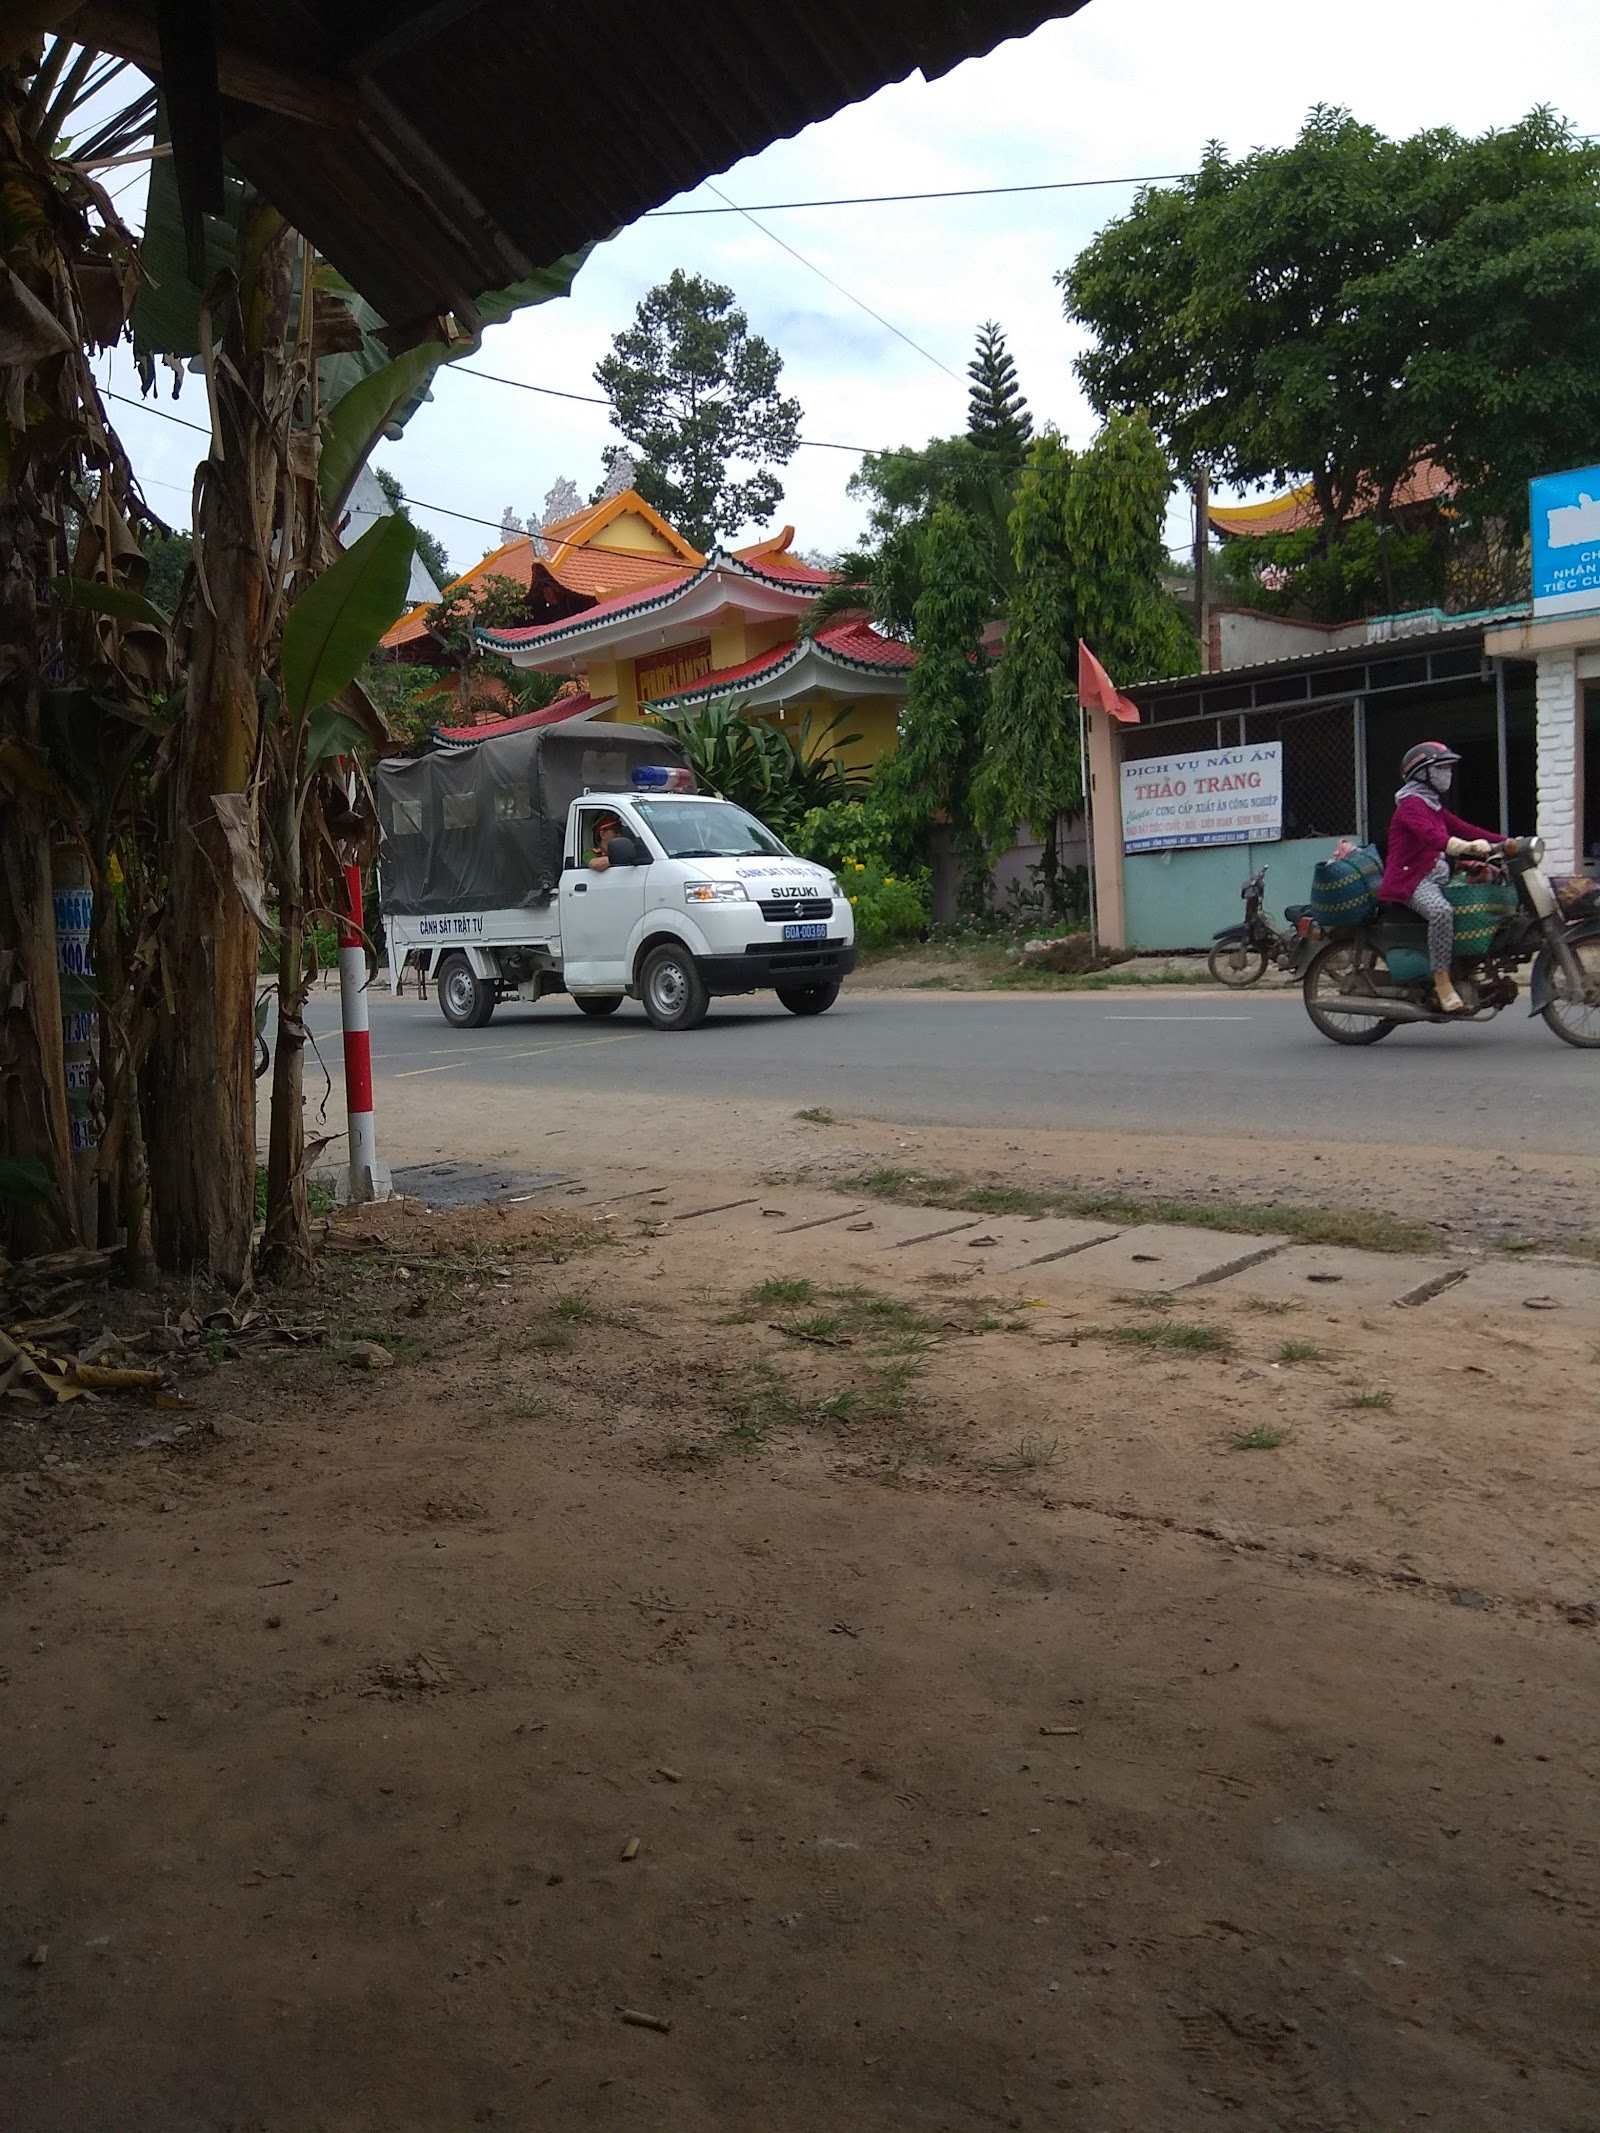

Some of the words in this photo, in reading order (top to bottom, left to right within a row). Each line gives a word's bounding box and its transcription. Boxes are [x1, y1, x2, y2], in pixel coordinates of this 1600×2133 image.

[1543, 579, 1577, 593] TIỆC
[1126, 764, 1169, 778] DỊCH
[1175, 760, 1199, 772] VỤ
[1206, 751, 1244, 768] NẤU
[1250, 750, 1276, 762] ĂN
[1134, 776, 1187, 801] THẢO
[1194, 772, 1262, 795] TRANG
[1156, 805, 1176, 817] CUNG
[1178, 800, 1193, 814] CẤP
[771, 886, 818, 898] SUZUKI
[420, 915, 438, 934] CẢNH
[439, 916, 452, 934] SÁT
[454, 916, 471, 936] TRẬT
[472, 915, 484, 935] TỰ
[786, 925, 826, 939] 60A-003.66
